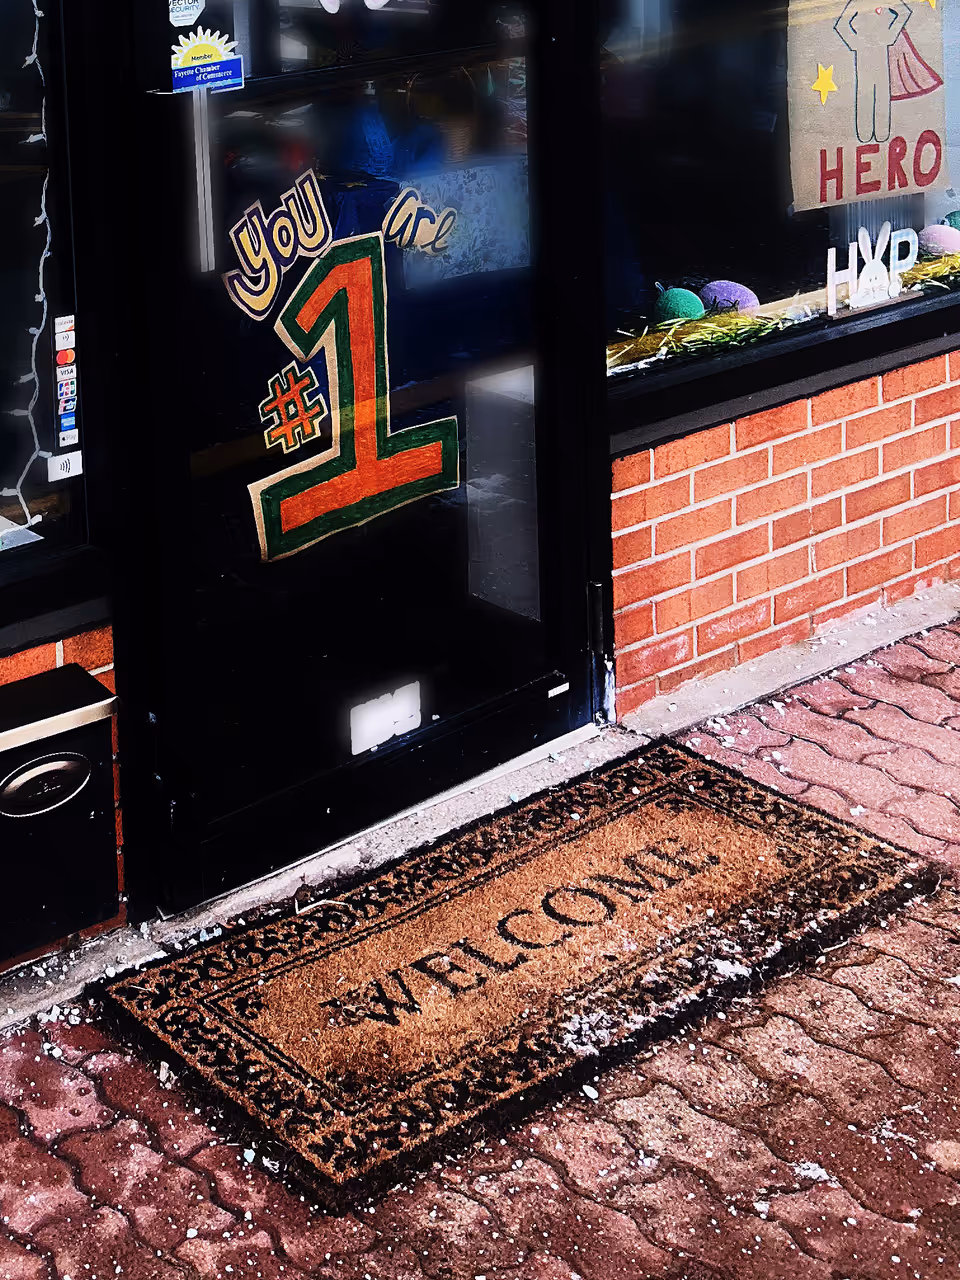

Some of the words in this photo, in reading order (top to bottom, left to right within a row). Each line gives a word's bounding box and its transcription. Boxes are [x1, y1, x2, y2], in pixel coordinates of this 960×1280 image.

[174, 69, 194, 78] Fayette
[194, 64, 221, 74] Chamber
[191, 53, 213, 62] Member
[202, 70, 233, 80] Commerce
[820, 129, 942, 203] HERO
[384, 188, 457, 253] are
[827, 226, 919, 316] HP
[319, 846, 724, 1027] WELCOME
